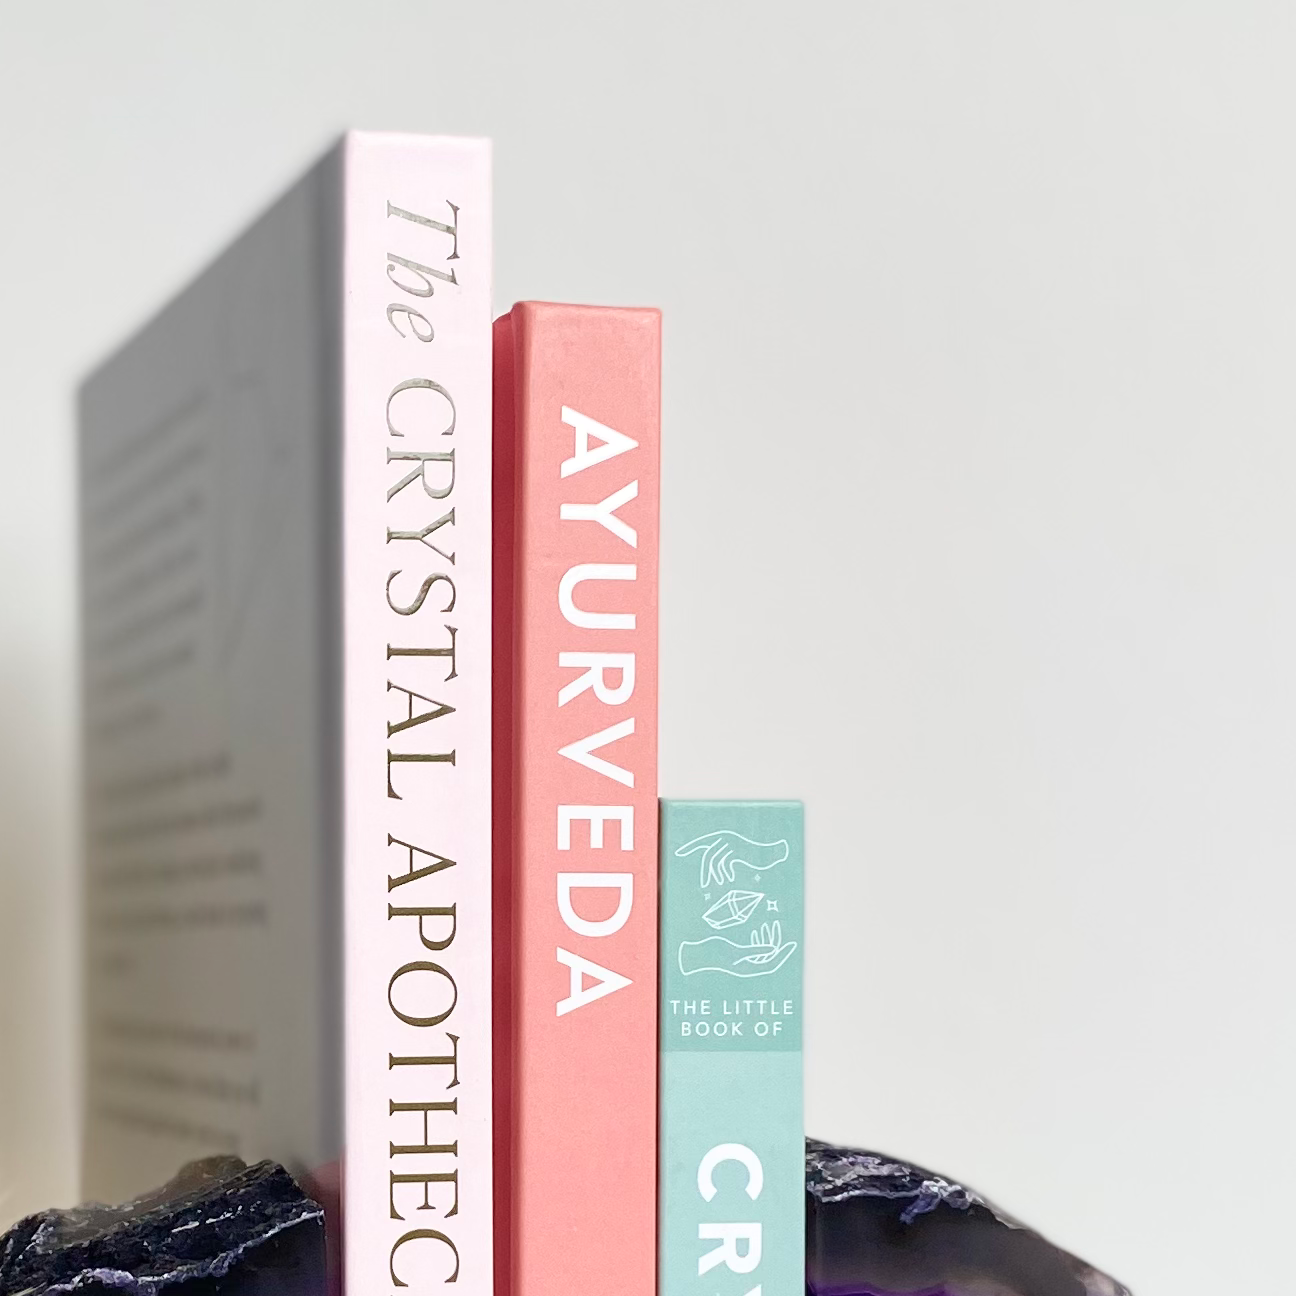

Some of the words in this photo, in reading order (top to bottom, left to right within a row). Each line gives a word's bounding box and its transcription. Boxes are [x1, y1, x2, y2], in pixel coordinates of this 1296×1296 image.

[386, 199, 461, 343] The
[386, 378, 458, 801] CRYSTAL
[556, 404, 640, 1018] AYURVEDA
[670, 1000, 711, 1015] THE
[723, 1000, 794, 1015] LITTLE
[681, 1021, 743, 1037] BOOK
[754, 1021, 783, 1037] OF
